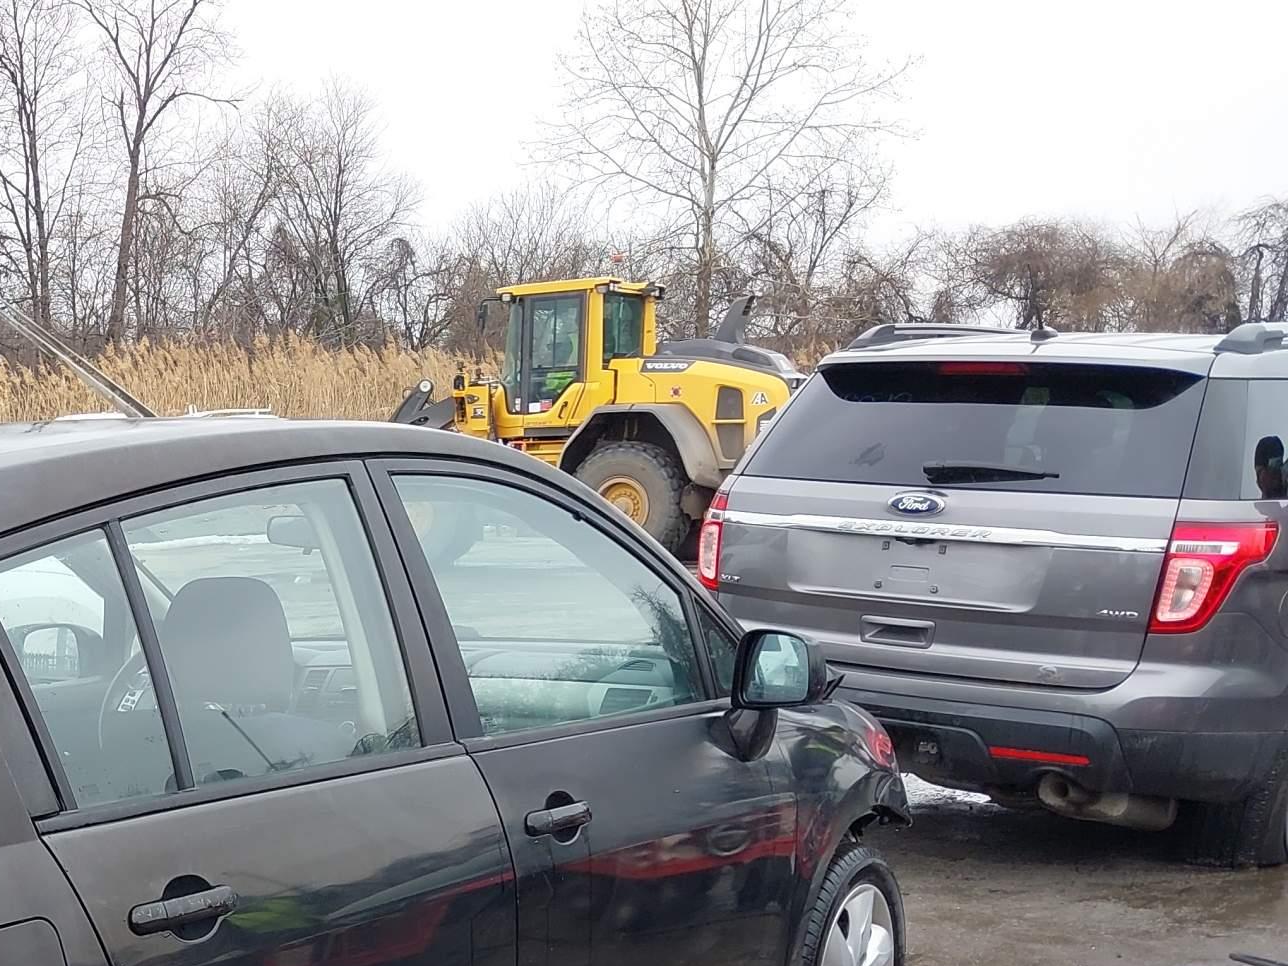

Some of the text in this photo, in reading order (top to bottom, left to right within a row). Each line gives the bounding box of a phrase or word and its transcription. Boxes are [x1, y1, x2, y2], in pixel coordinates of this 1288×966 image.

[645, 362, 689, 370] VOLVO
[898, 495, 930, 513] Ford
[837, 520, 993, 540] EXPLORER
